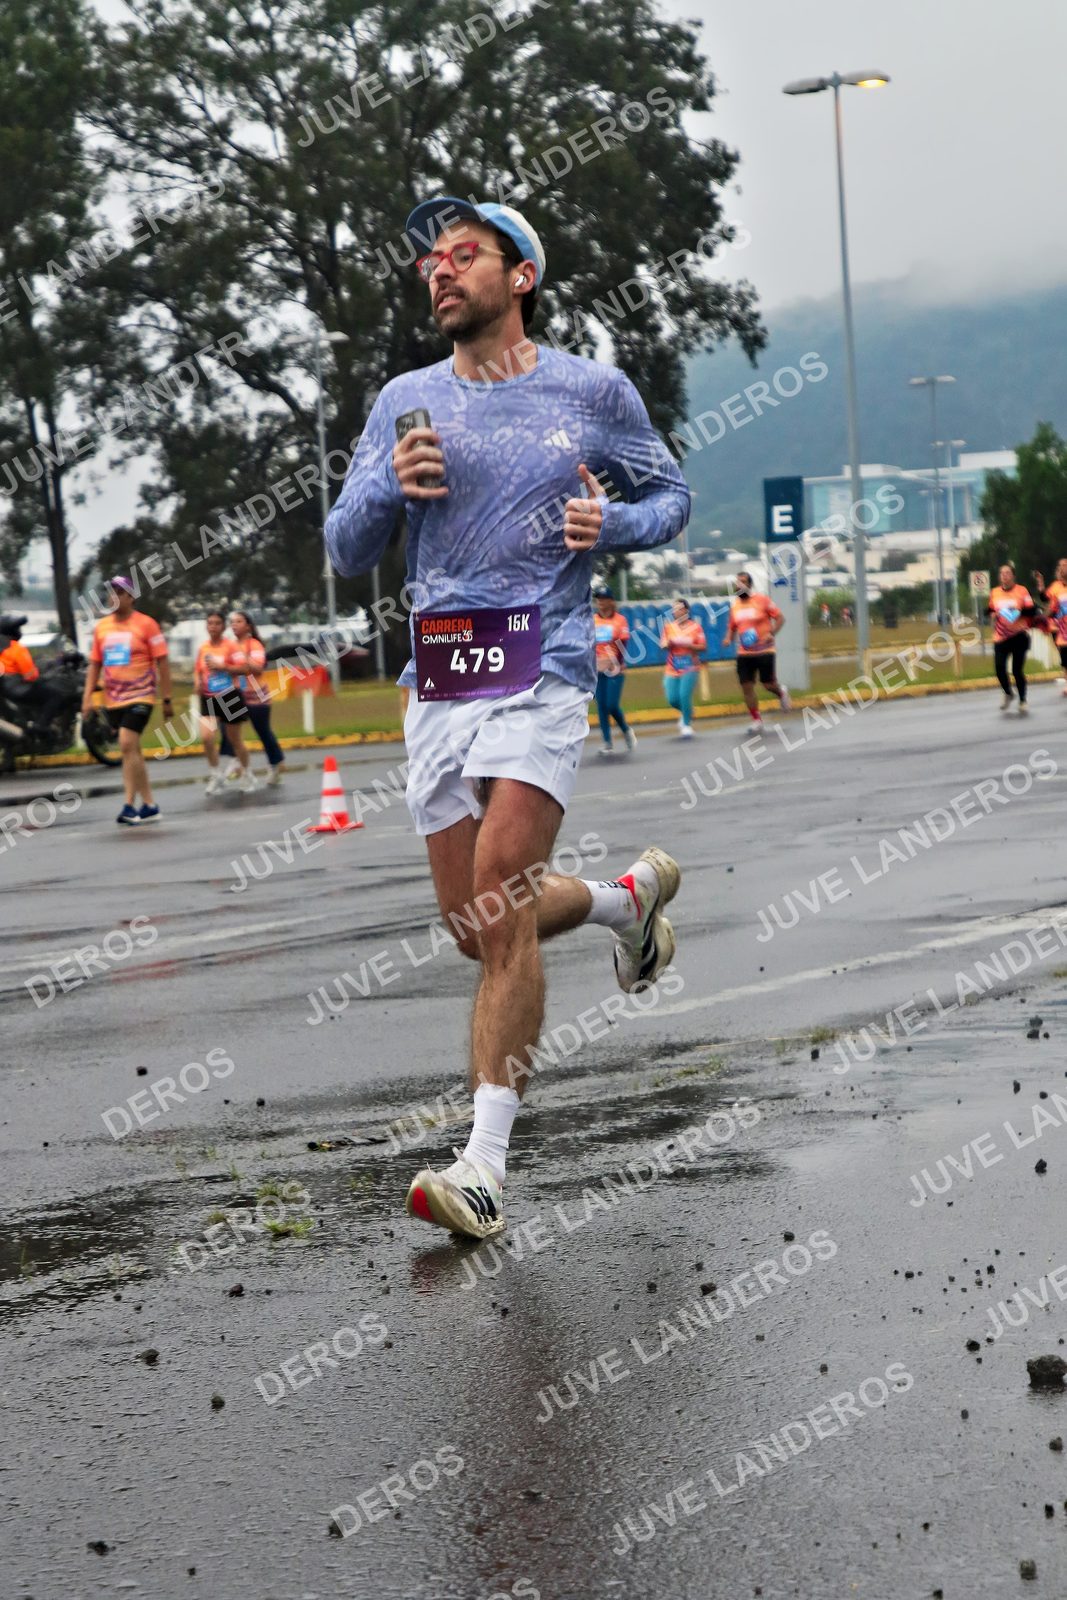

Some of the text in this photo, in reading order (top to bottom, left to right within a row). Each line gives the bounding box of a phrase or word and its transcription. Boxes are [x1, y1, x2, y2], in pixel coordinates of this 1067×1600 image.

[772, 504, 794, 533] E
[421, 618, 473, 634] CARRERA
[507, 613, 531, 632] 15K
[422, 633, 462, 644] OMNILIFE
[450, 646, 505, 674] 479
